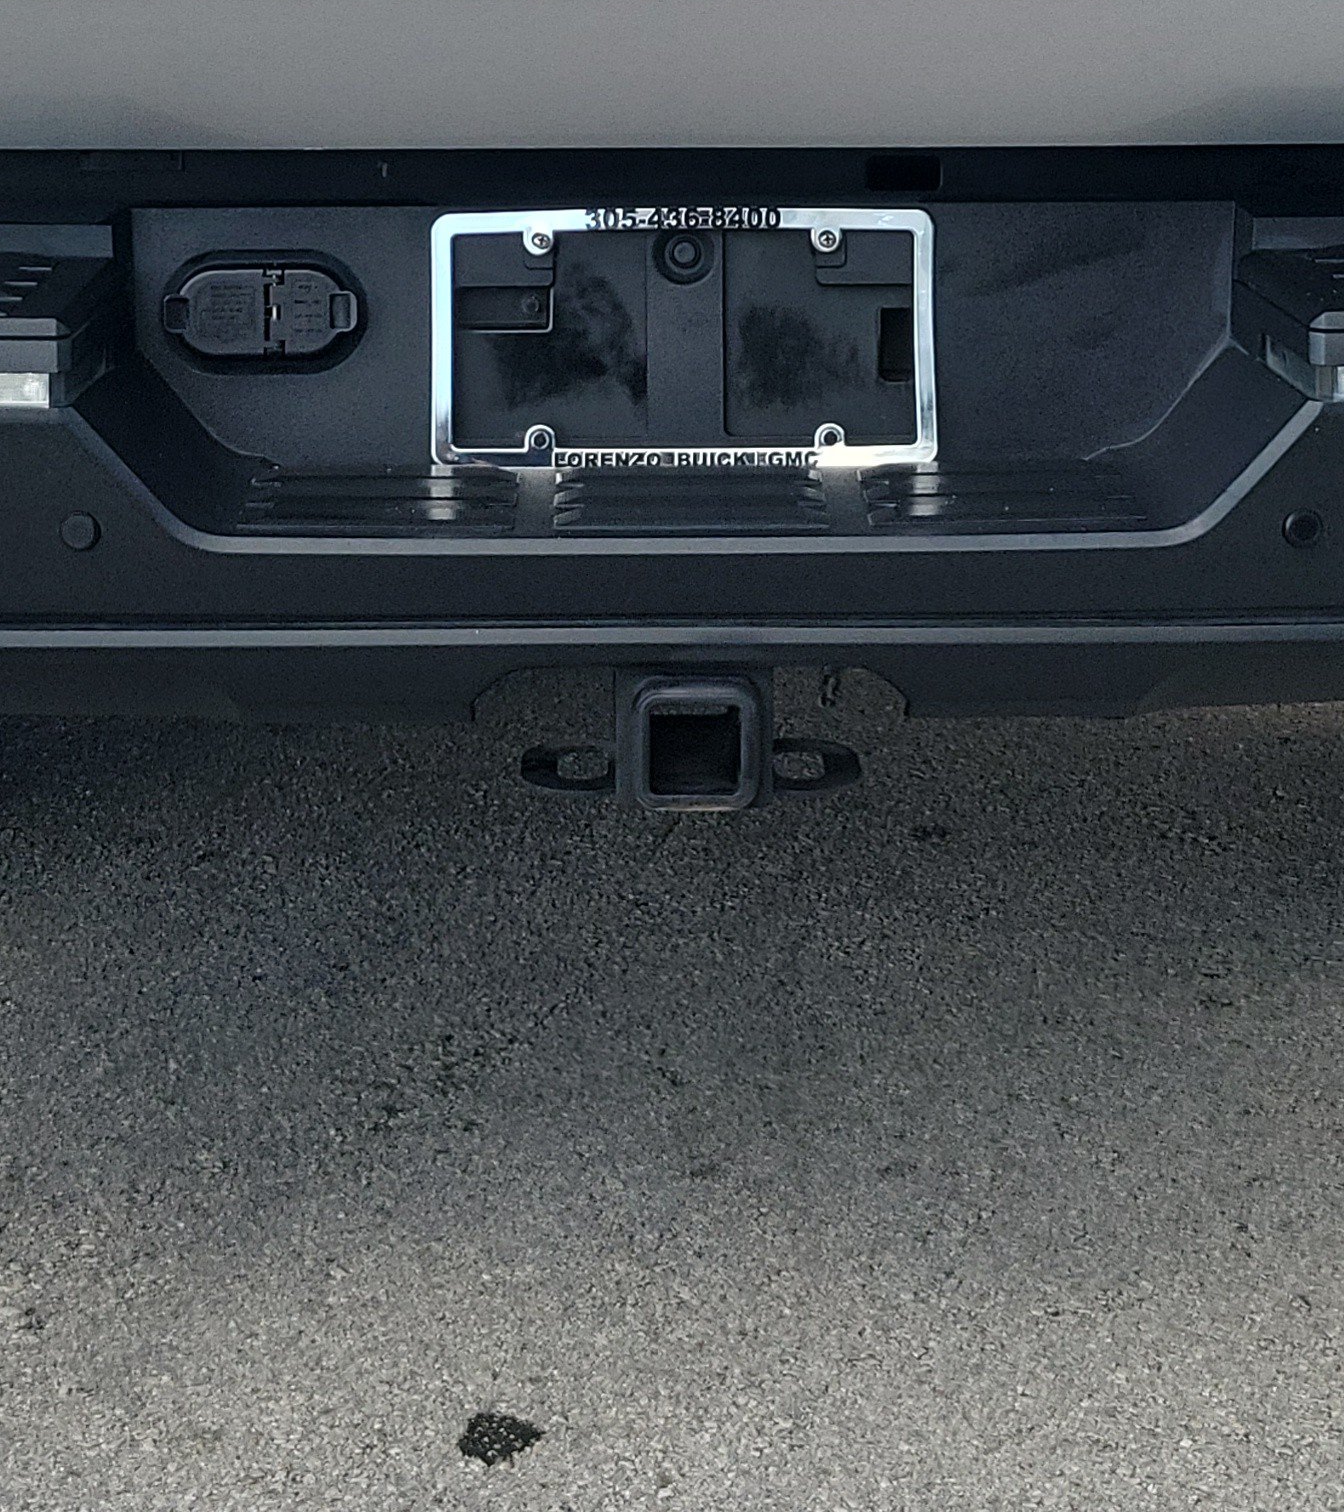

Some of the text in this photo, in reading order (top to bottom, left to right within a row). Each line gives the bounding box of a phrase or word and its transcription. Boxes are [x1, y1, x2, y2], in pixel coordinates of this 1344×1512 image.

[584, 206, 782, 231] 305-436-8400
[554, 450, 662, 469] LORENZO
[675, 450, 749, 468] BUICK
